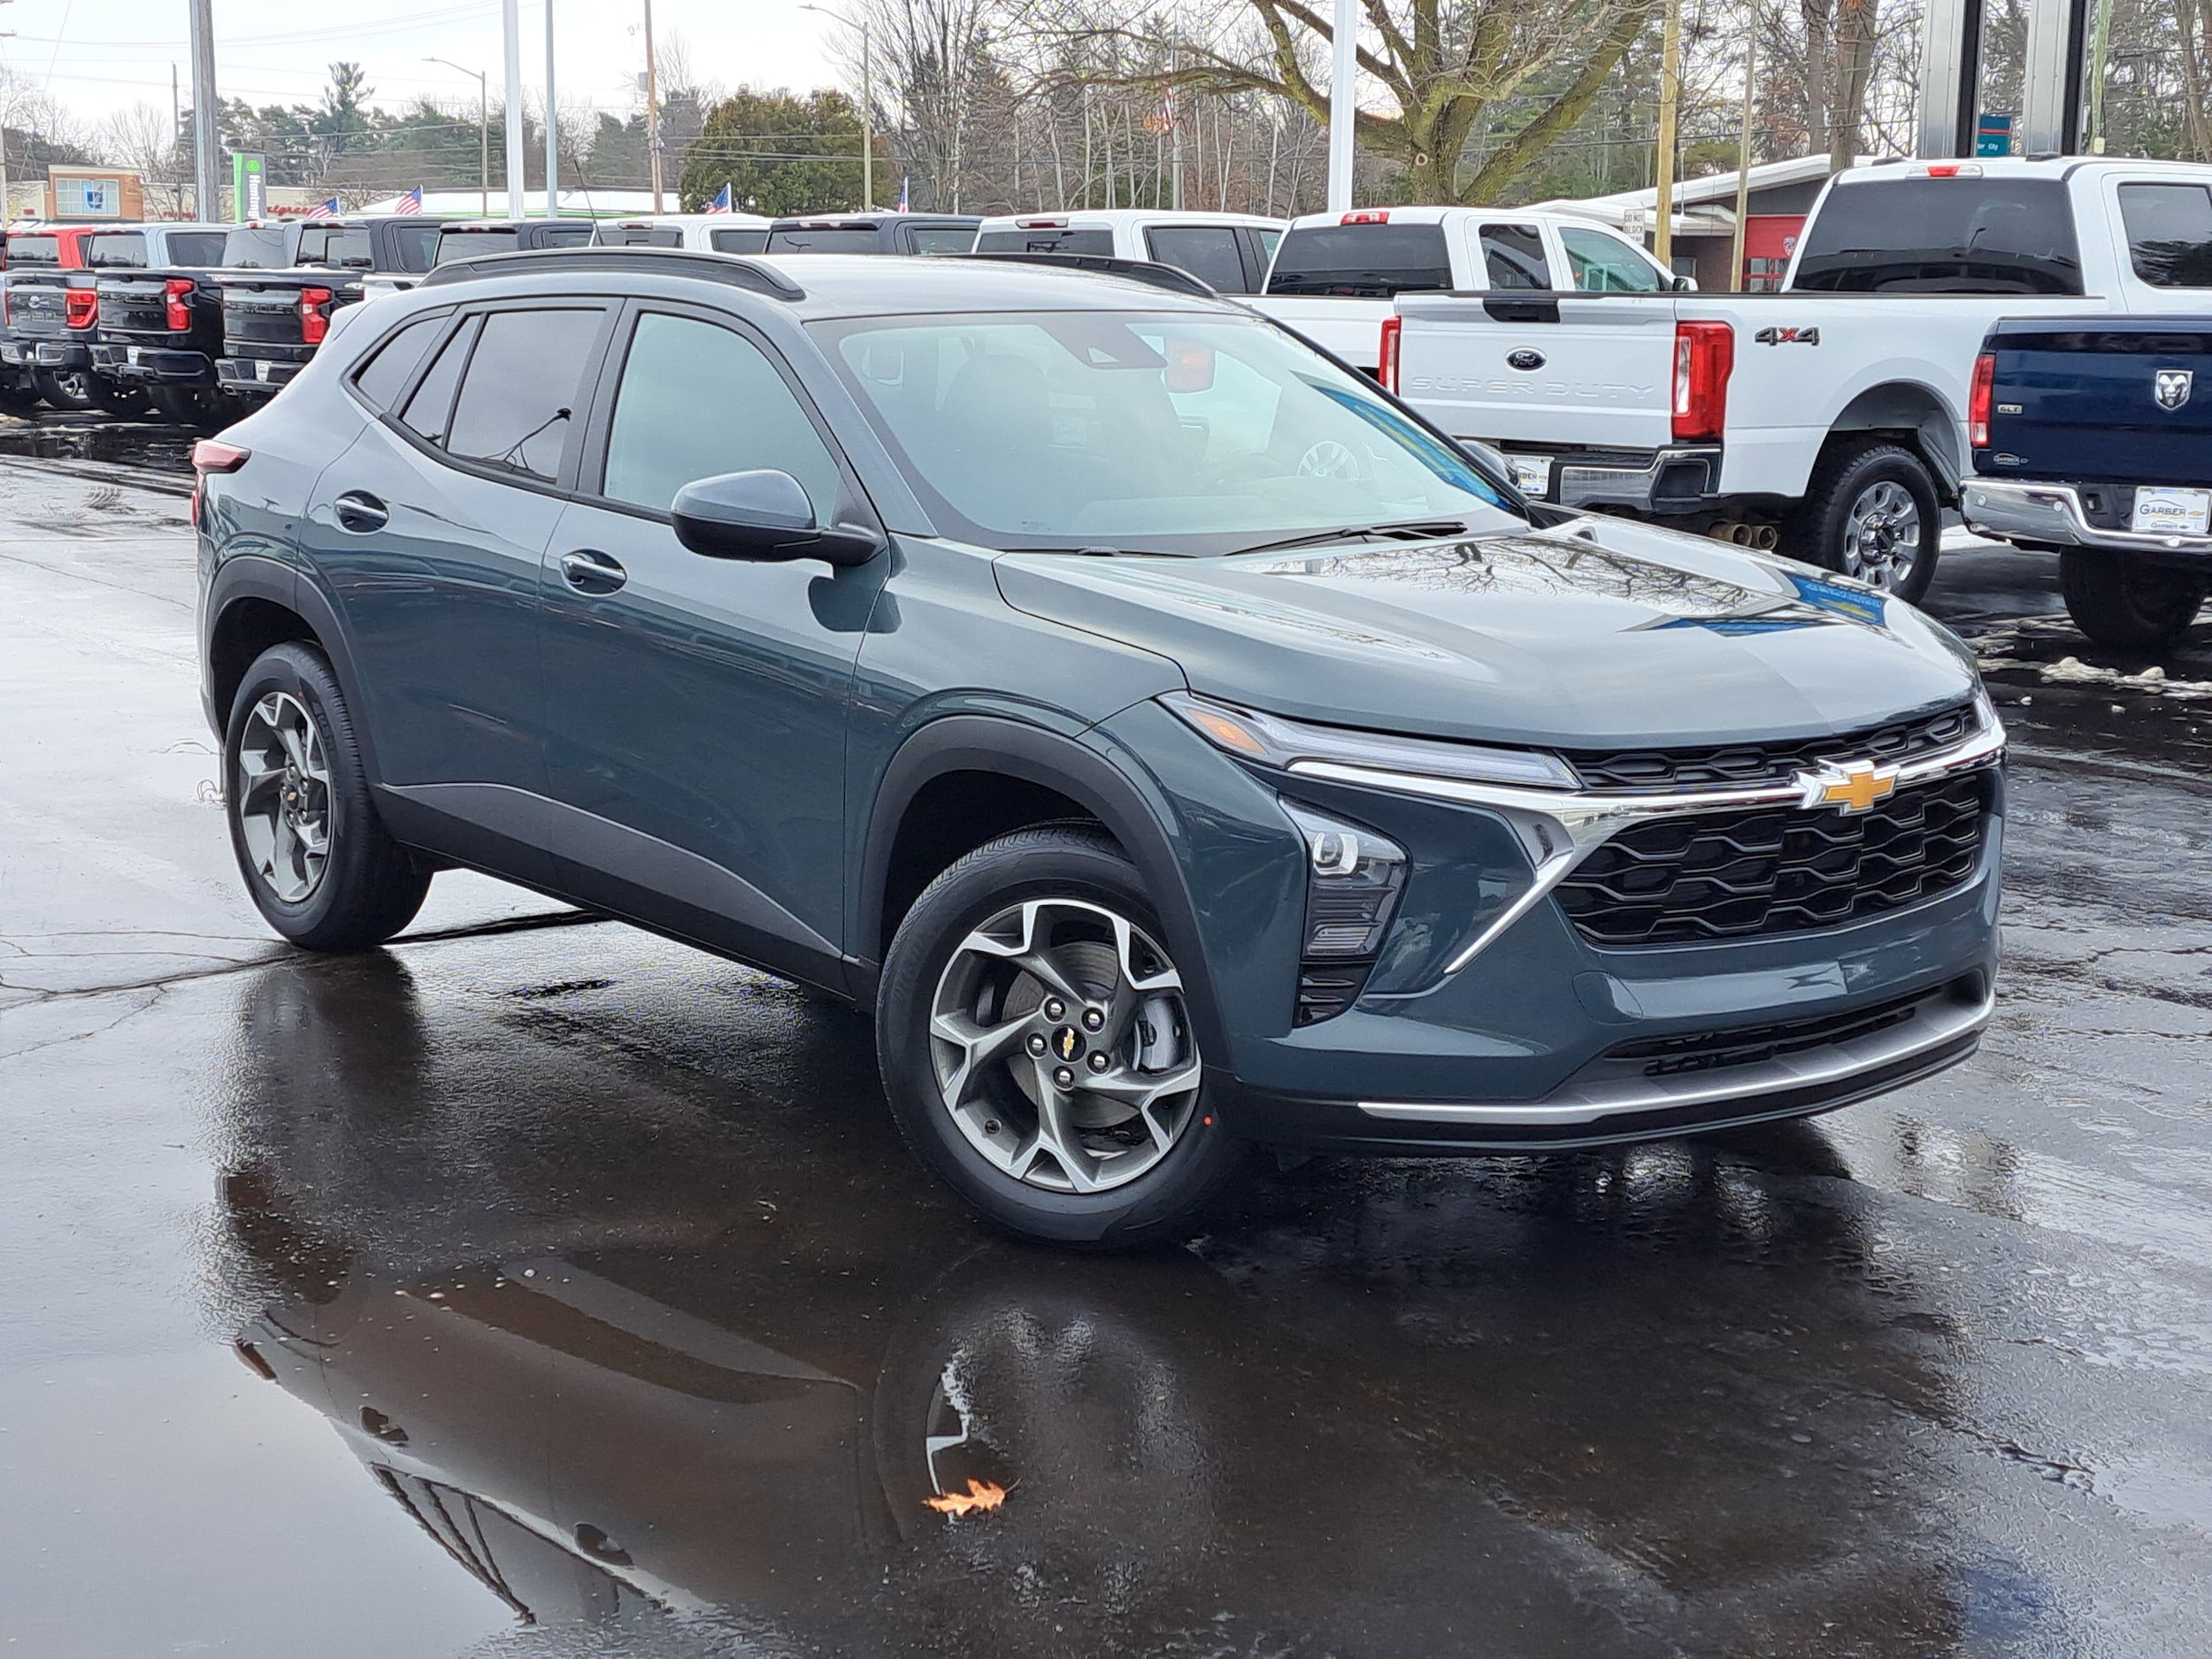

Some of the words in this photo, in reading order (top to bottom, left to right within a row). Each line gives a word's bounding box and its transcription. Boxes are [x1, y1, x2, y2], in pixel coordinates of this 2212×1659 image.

[1411, 375, 1535, 395] SUPER
[1545, 380, 1655, 400] DUTY
[2139, 503, 2186, 516] GARBER
